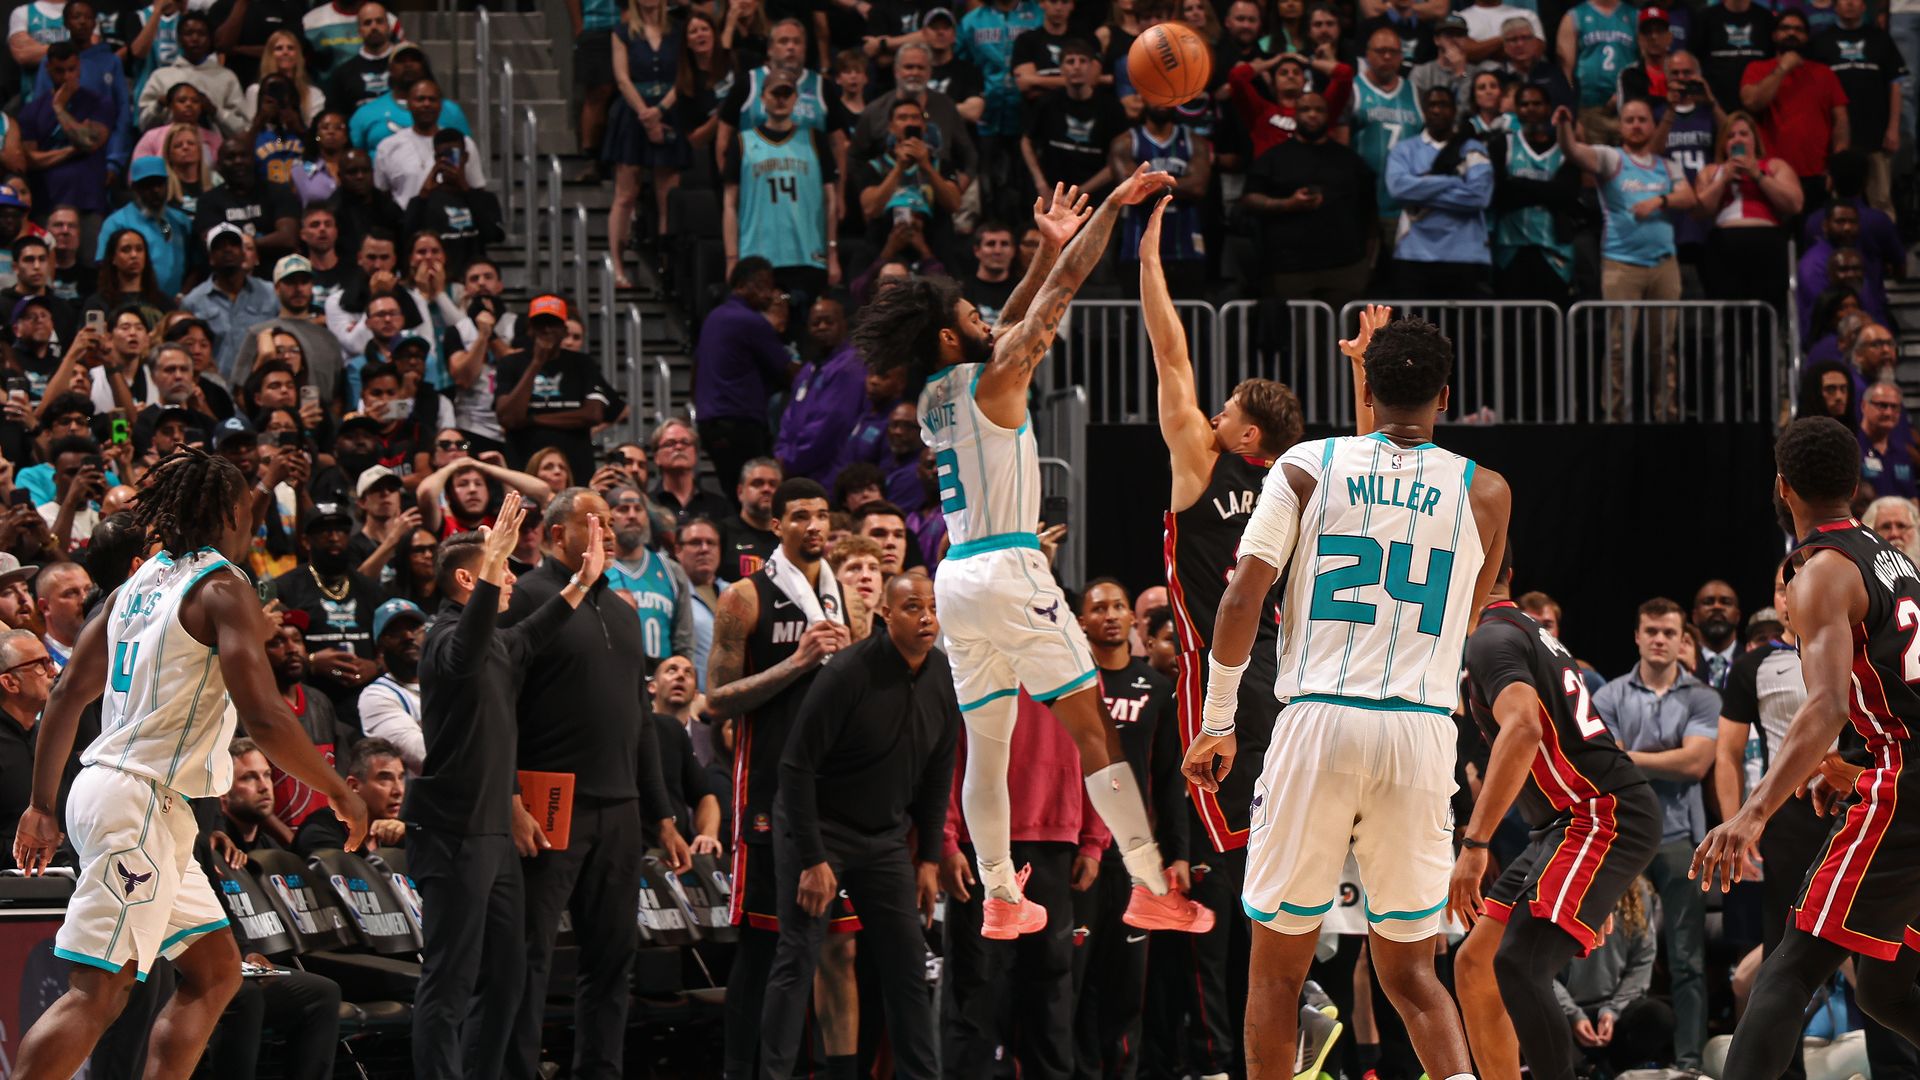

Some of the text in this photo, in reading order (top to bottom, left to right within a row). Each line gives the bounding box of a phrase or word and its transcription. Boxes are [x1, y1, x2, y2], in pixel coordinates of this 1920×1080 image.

[1154, 26, 1179, 72] Wilson
[1602, 45, 1616, 71] 2
[767, 176, 797, 204] 14
[921, 402, 957, 437] WHITE
[1212, 490, 1260, 521] LAR
[1346, 474, 1442, 517] MILLER
[1309, 534, 1455, 638] 24
[110, 641, 140, 693] 4
[546, 786, 561, 832] Wilson
